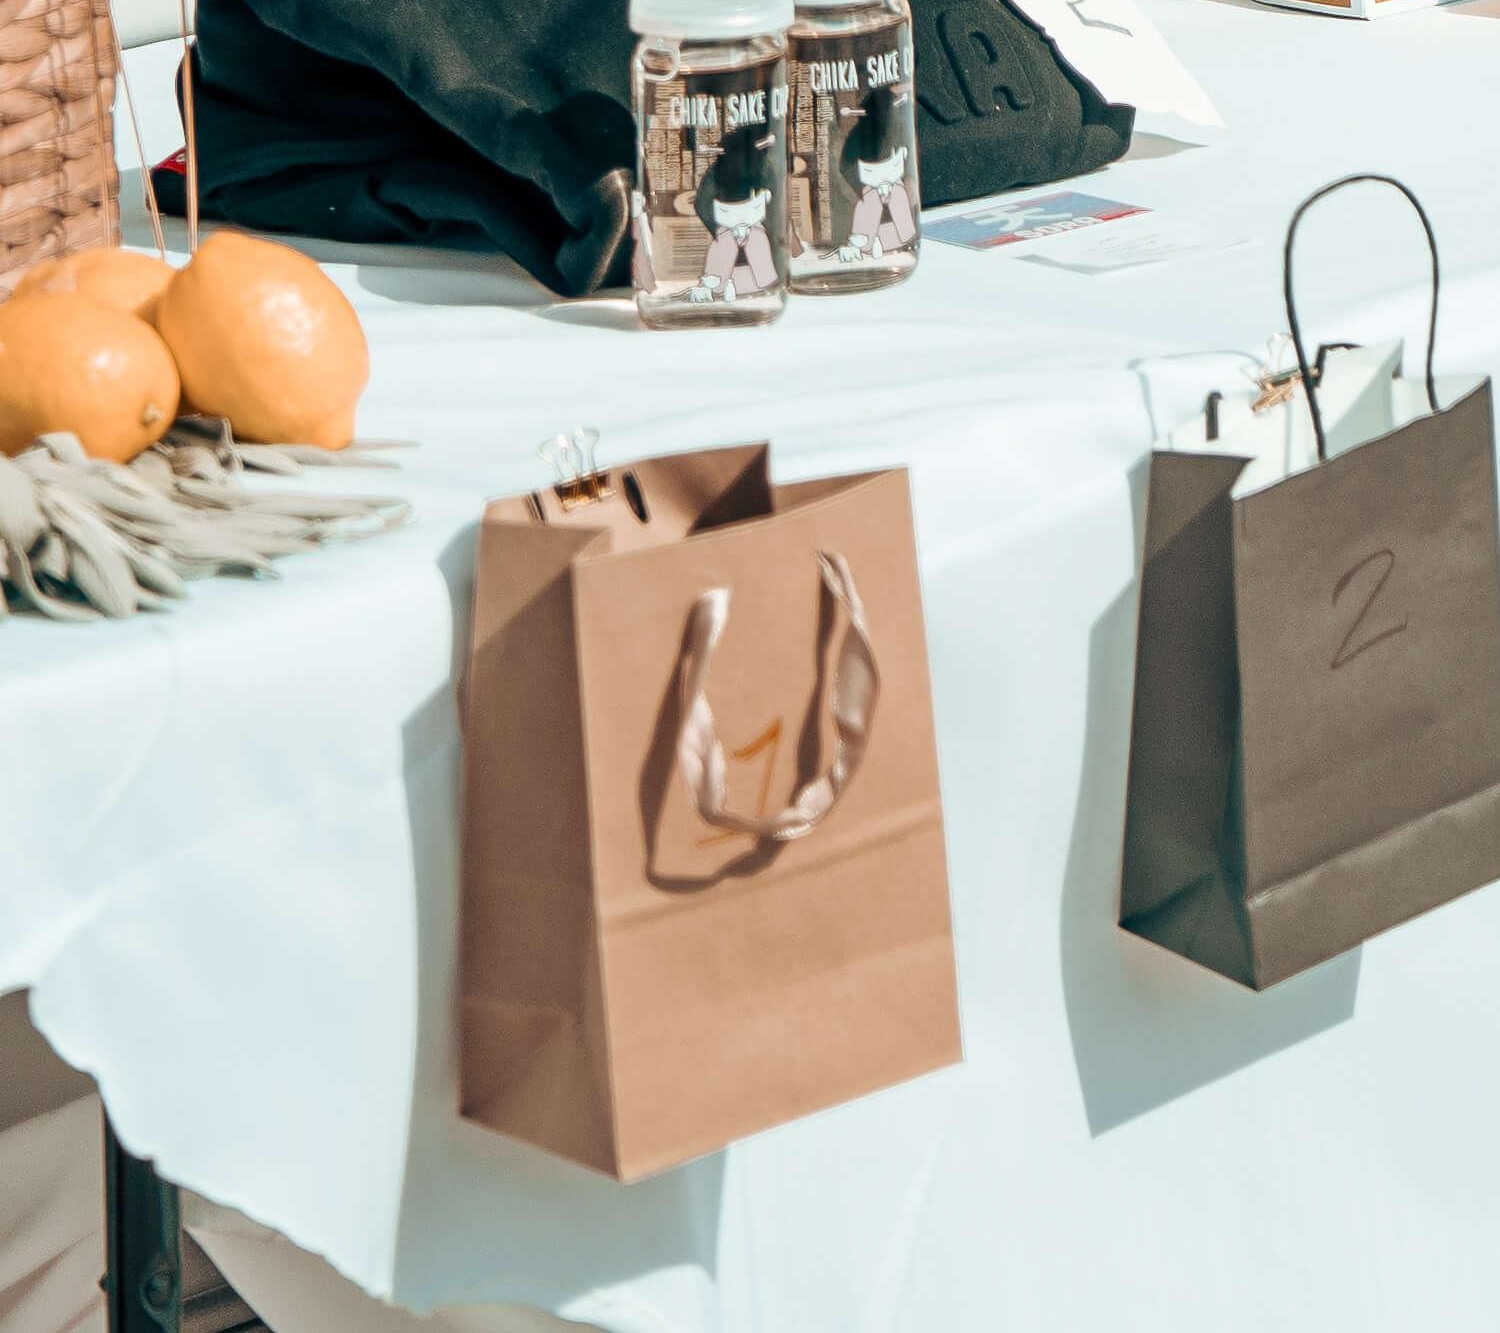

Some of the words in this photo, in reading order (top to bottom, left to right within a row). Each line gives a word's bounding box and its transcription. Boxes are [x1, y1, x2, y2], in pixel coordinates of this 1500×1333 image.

[809, 58, 858, 94] CHIKA
[866, 50, 901, 88] SAKE
[669, 94, 718, 126] CHIKA
[727, 90, 767, 126] SAKE
[1328, 548, 1409, 672] 2
